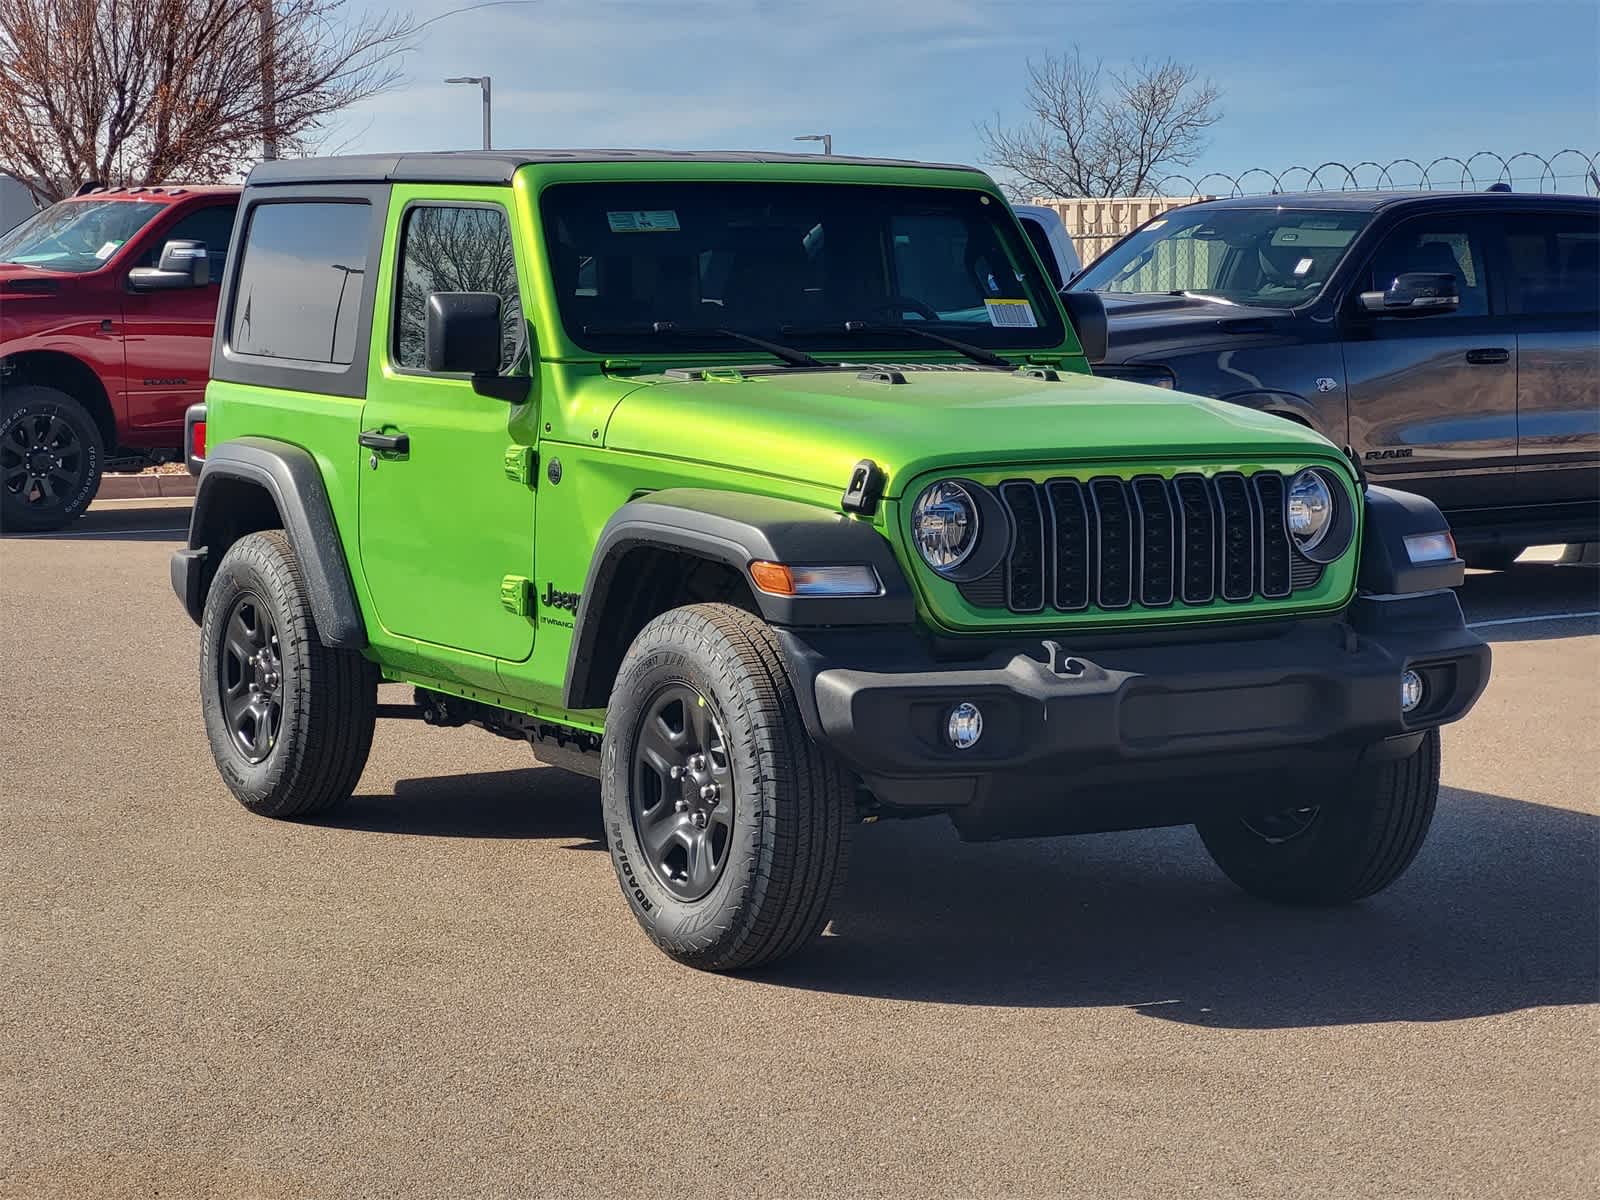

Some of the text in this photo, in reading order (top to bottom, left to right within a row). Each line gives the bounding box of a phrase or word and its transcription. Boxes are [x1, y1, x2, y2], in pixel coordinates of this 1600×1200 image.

[1365, 448, 1413, 460] RAM
[541, 582, 580, 617] Jeep
[610, 821, 655, 913] ROADIAN
